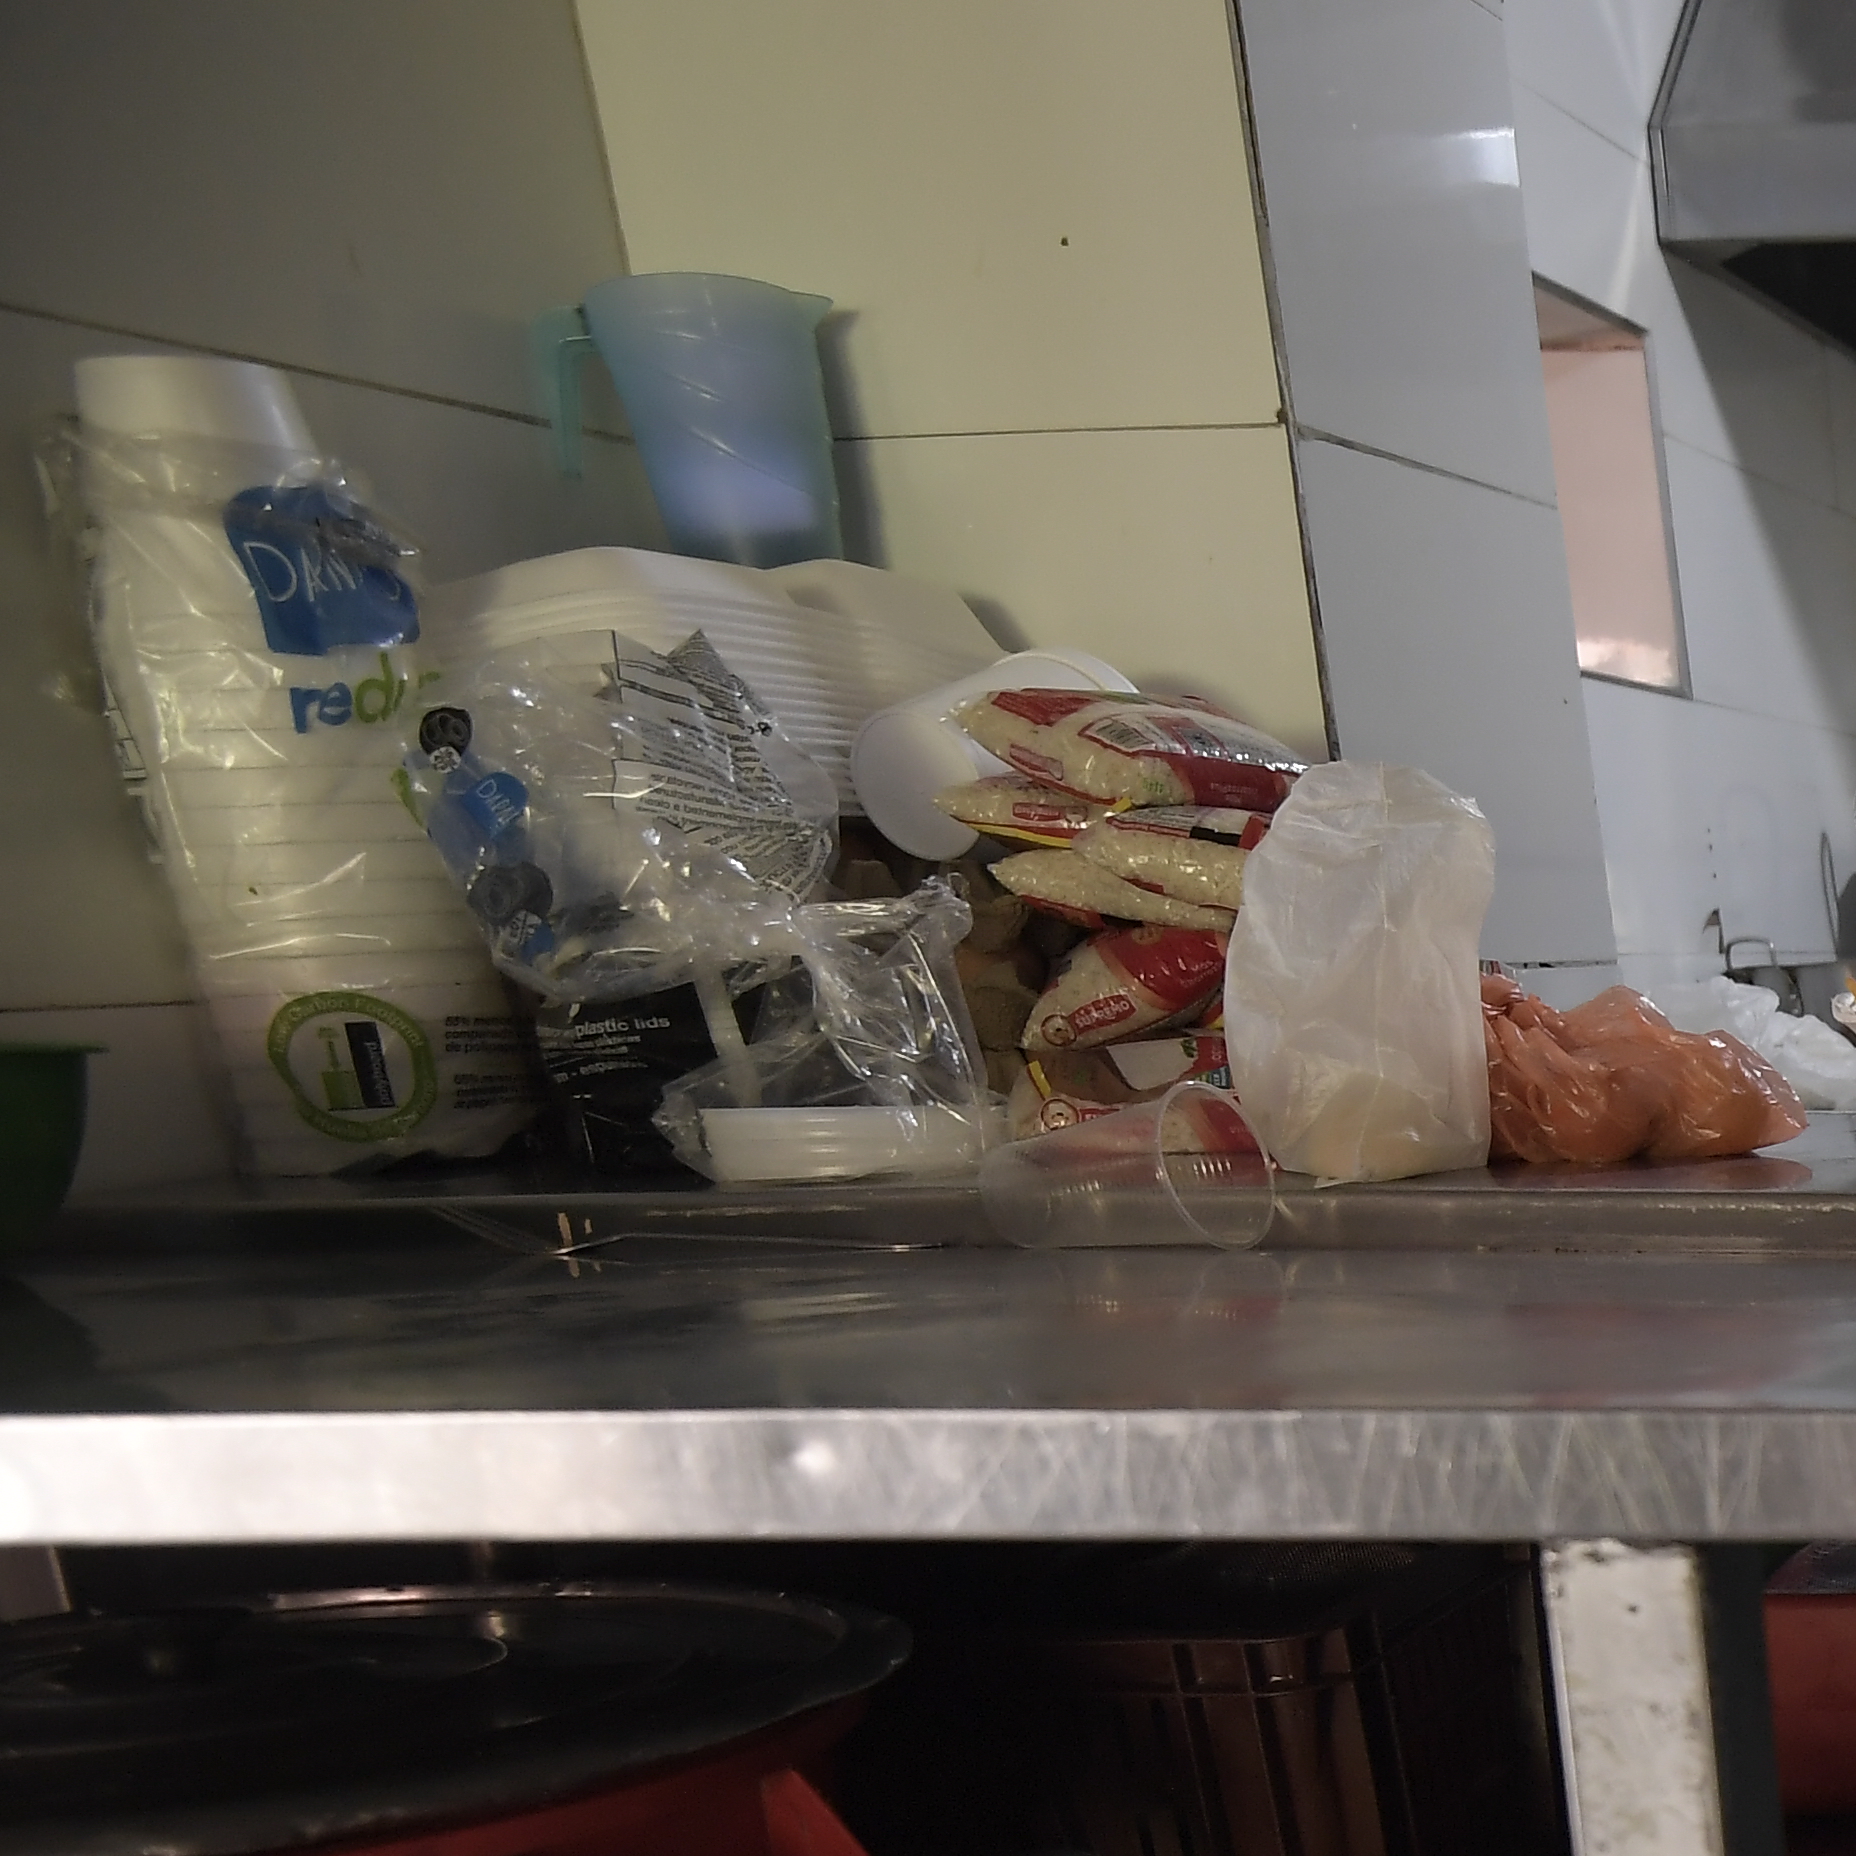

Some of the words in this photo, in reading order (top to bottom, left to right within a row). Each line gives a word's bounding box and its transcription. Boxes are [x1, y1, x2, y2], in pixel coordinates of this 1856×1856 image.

[1075, 1000, 1131, 1029] SUPREMO
[574, 1018, 629, 1040] plastic
[633, 1016, 671, 1030] lids
